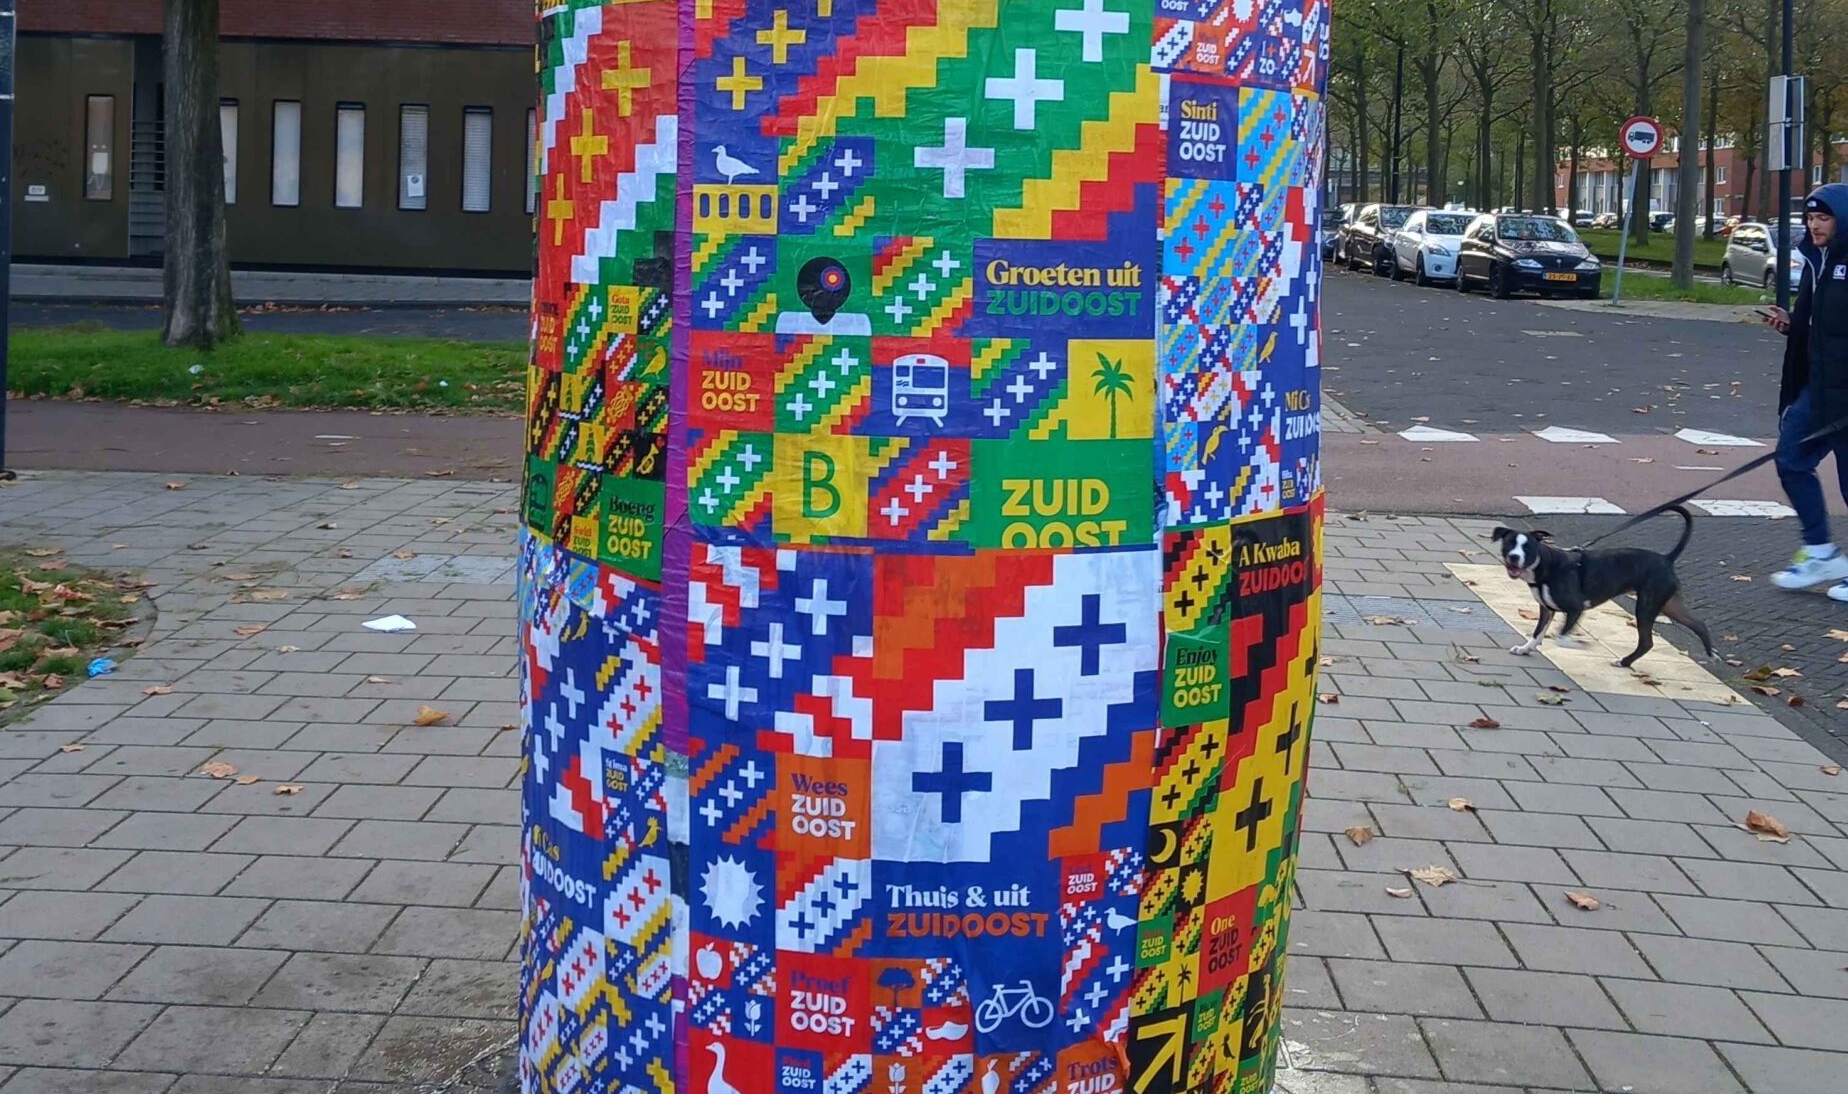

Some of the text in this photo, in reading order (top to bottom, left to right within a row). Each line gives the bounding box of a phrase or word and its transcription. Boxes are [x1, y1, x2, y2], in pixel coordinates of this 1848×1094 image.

[1161, 0, 1189, 12] OOST
[1196, 42, 1218, 54] ZUID
[1196, 52, 1220, 65] OOST
[1179, 120, 1221, 142] ZUID
[1179, 141, 1227, 163] OOST
[985, 259, 1142, 287] Groeten uit
[611, 305, 630, 315] ZUID
[986, 290, 1142, 317] ZUIDOOST
[611, 315, 633, 326] OOST
[702, 370, 751, 391] ZUID
[702, 391, 760, 412] OOST
[803, 450, 841, 519] B
[1001, 478, 1110, 516] ZUID
[608, 514, 646, 537] ZUID
[1001, 519, 1128, 549] OOST
[573, 536, 591, 548] ZUID
[607, 535, 652, 560] OOST
[1238, 536, 1300, 568] A Kwaba
[1239, 559, 1307, 597] ZUIDOO
[1175, 646, 1218, 667] Enjoy
[1174, 665, 1216, 688] ZUID
[1173, 683, 1223, 708] OOST
[790, 772, 848, 796] Wees
[791, 793, 847, 817] ZUID
[791, 814, 856, 841] OOST
[1066, 881, 1099, 895] OOST
[1068, 872, 1095, 885] ZUID
[886, 883, 1031, 909] Thuis & uit
[885, 912, 1049, 939] ZUIDOOST
[1210, 914, 1236, 936] One
[1140, 944, 1167, 959] OOST
[1141, 936, 1164, 949] ZUID
[1209, 927, 1239, 956] ZUID
[1207, 943, 1243, 975] OOST
[790, 989, 847, 1015] ZUID
[790, 1010, 855, 1038] OOST
[782, 1065, 811, 1078] ZUID
[1067, 1057, 1118, 1081] Trots
[781, 1076, 816, 1090] OOST
[1067, 1073, 1116, 1094] ZUID
